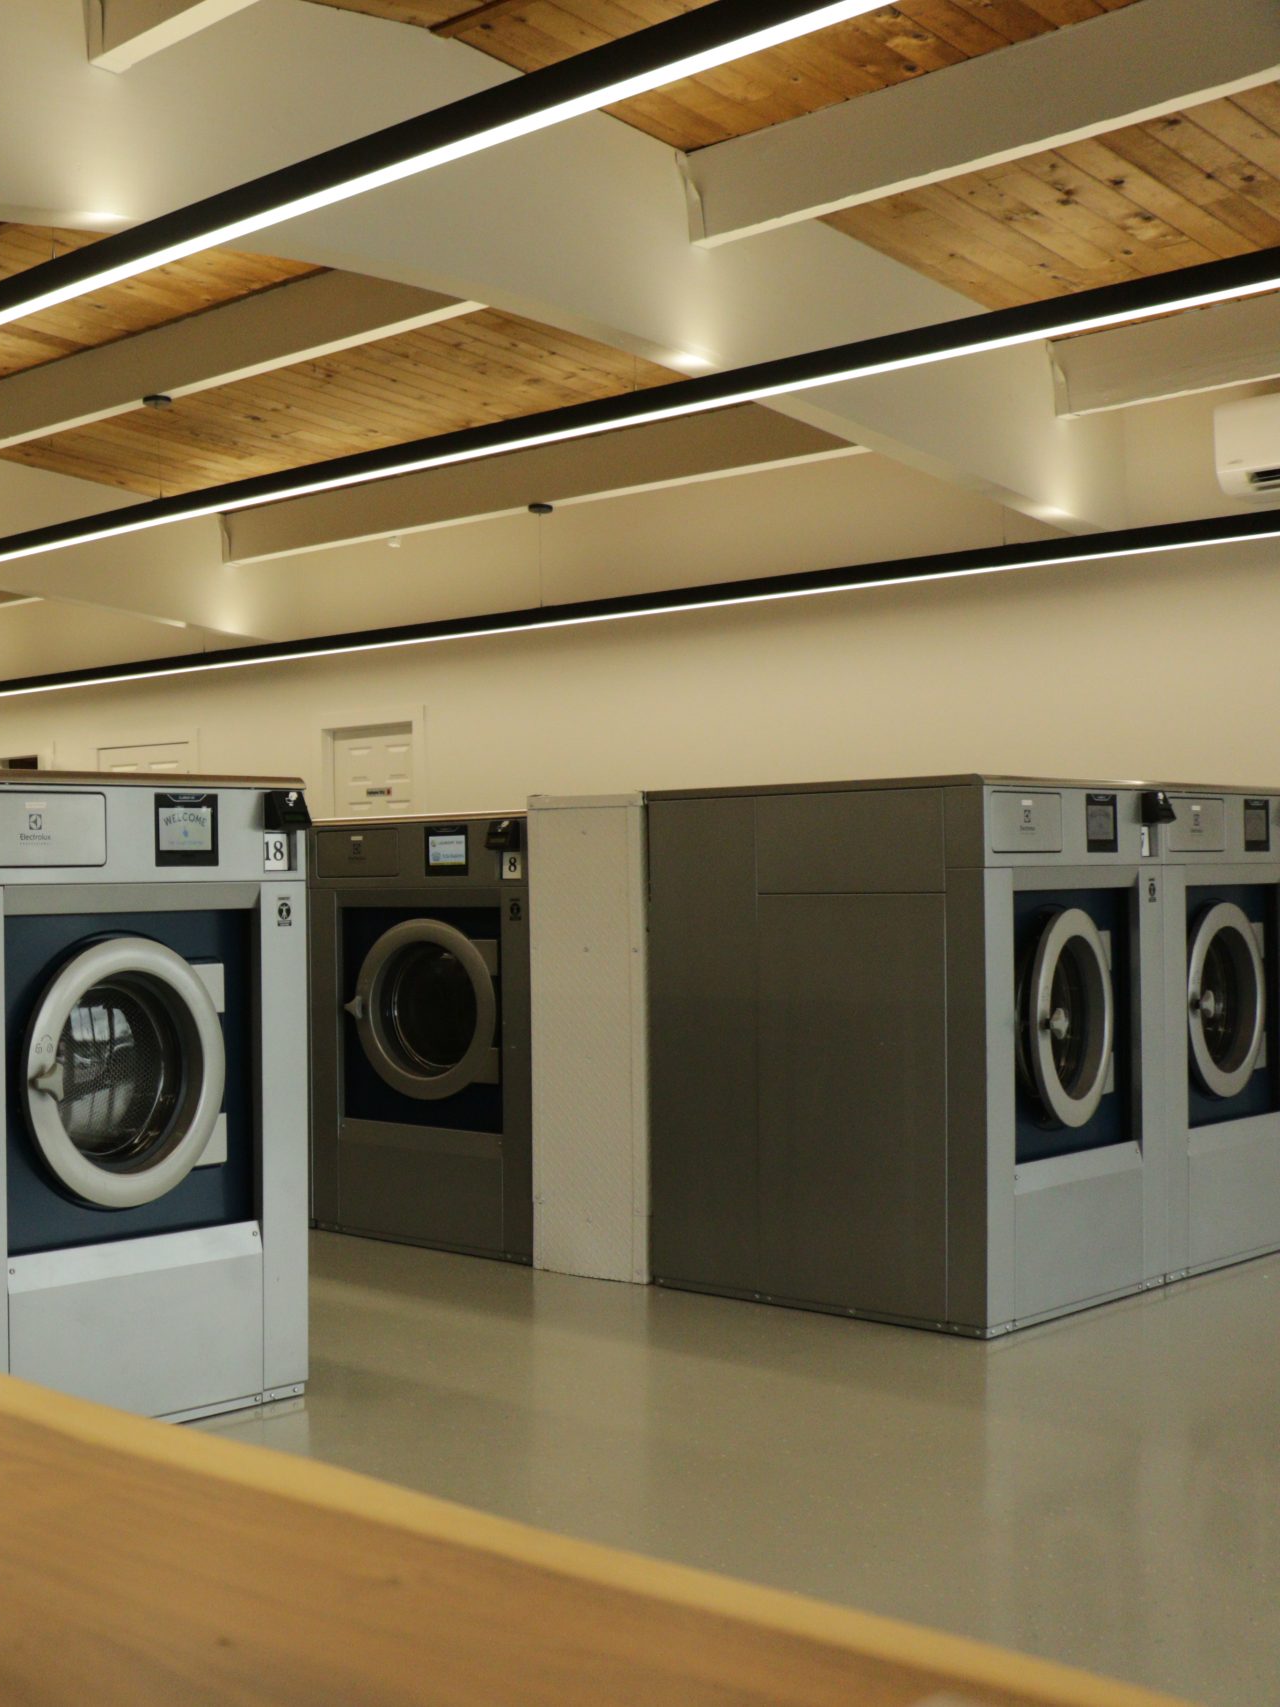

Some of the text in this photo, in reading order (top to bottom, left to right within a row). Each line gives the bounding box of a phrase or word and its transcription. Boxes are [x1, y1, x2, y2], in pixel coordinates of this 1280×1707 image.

[163, 812, 207, 828] WELCOME
[19, 833, 51, 841] Electrolux
[264, 840, 285, 861] 18
[508, 856, 518, 873] 8
